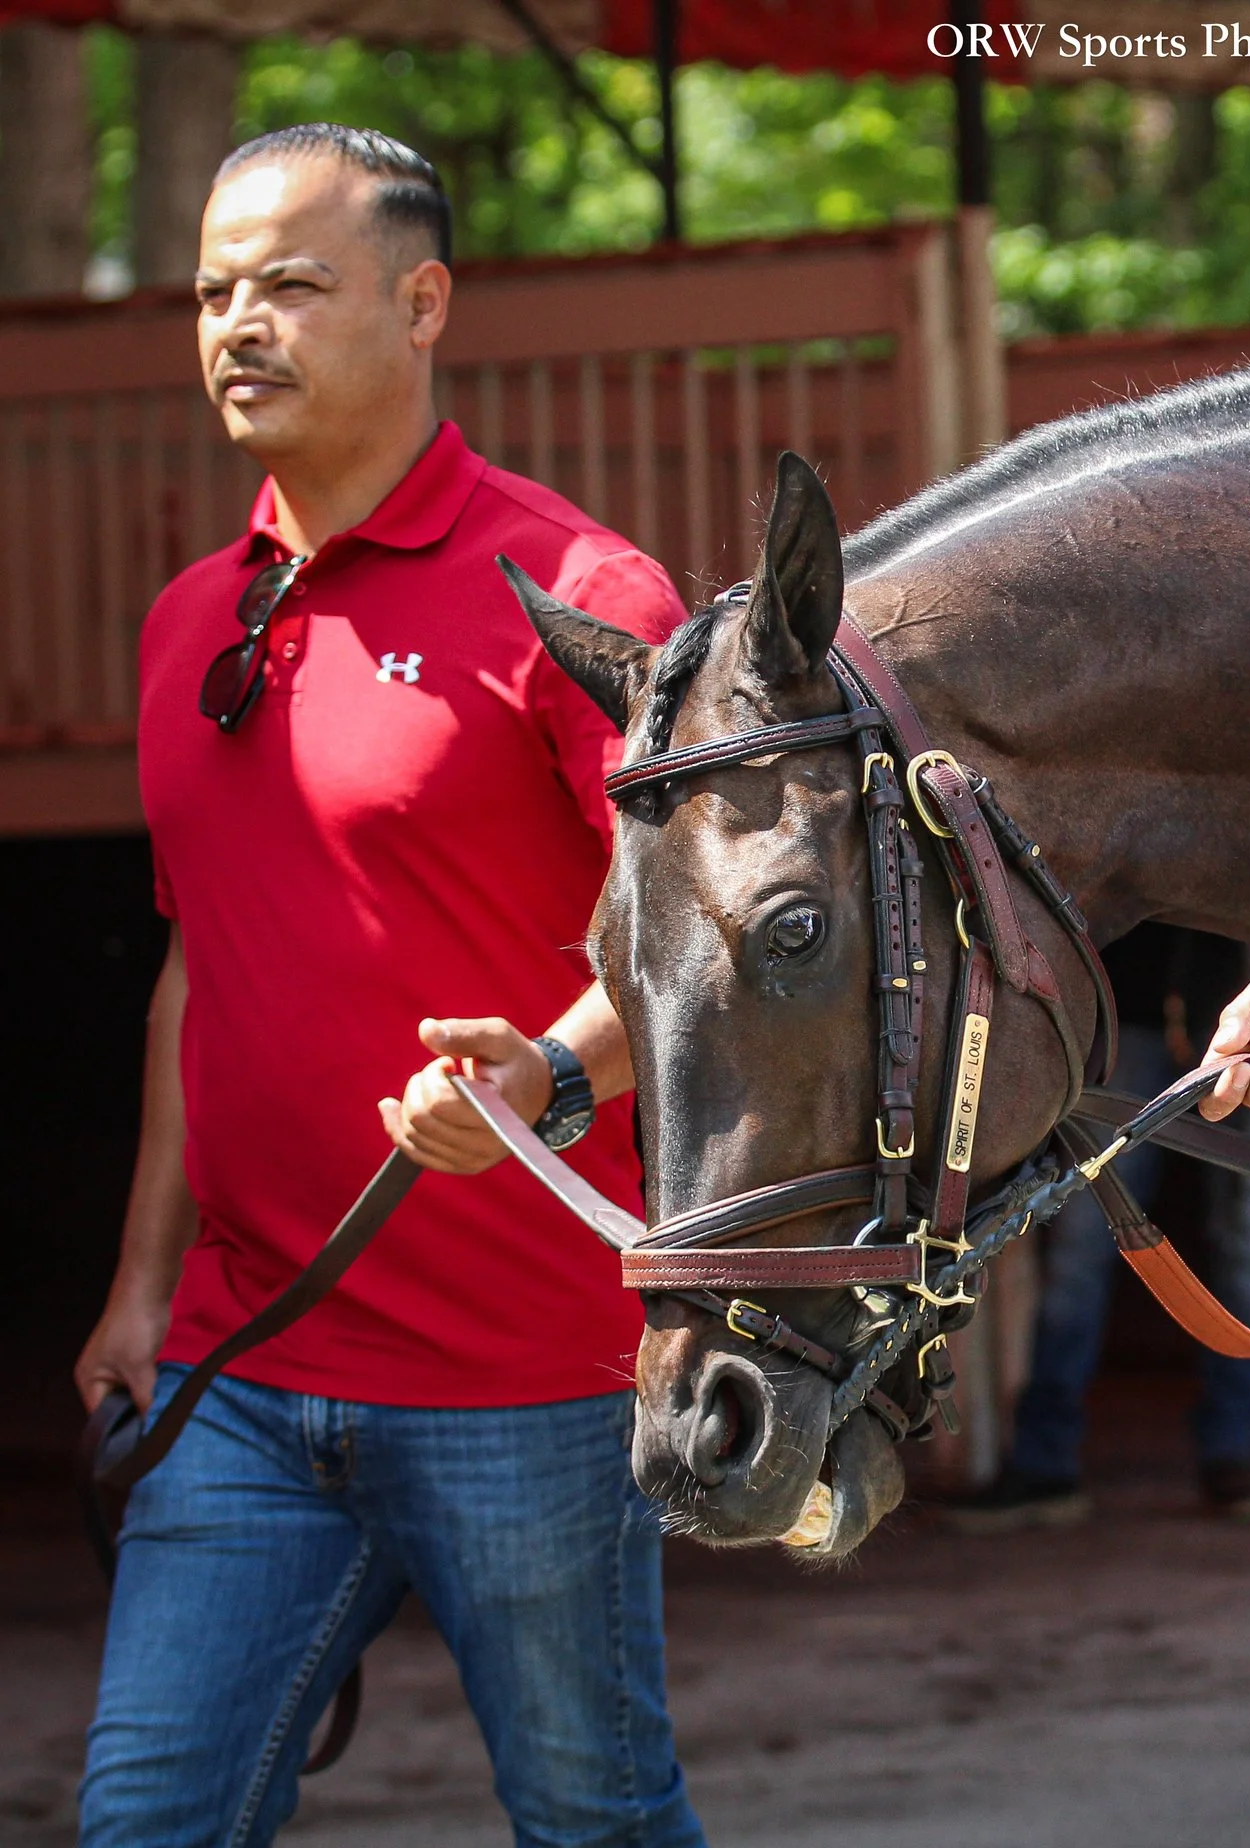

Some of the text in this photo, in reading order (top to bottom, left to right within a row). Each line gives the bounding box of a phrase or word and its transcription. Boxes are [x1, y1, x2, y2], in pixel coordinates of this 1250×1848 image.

[955, 1031, 983, 1157] SPIRIT OF ST. LOUIS
